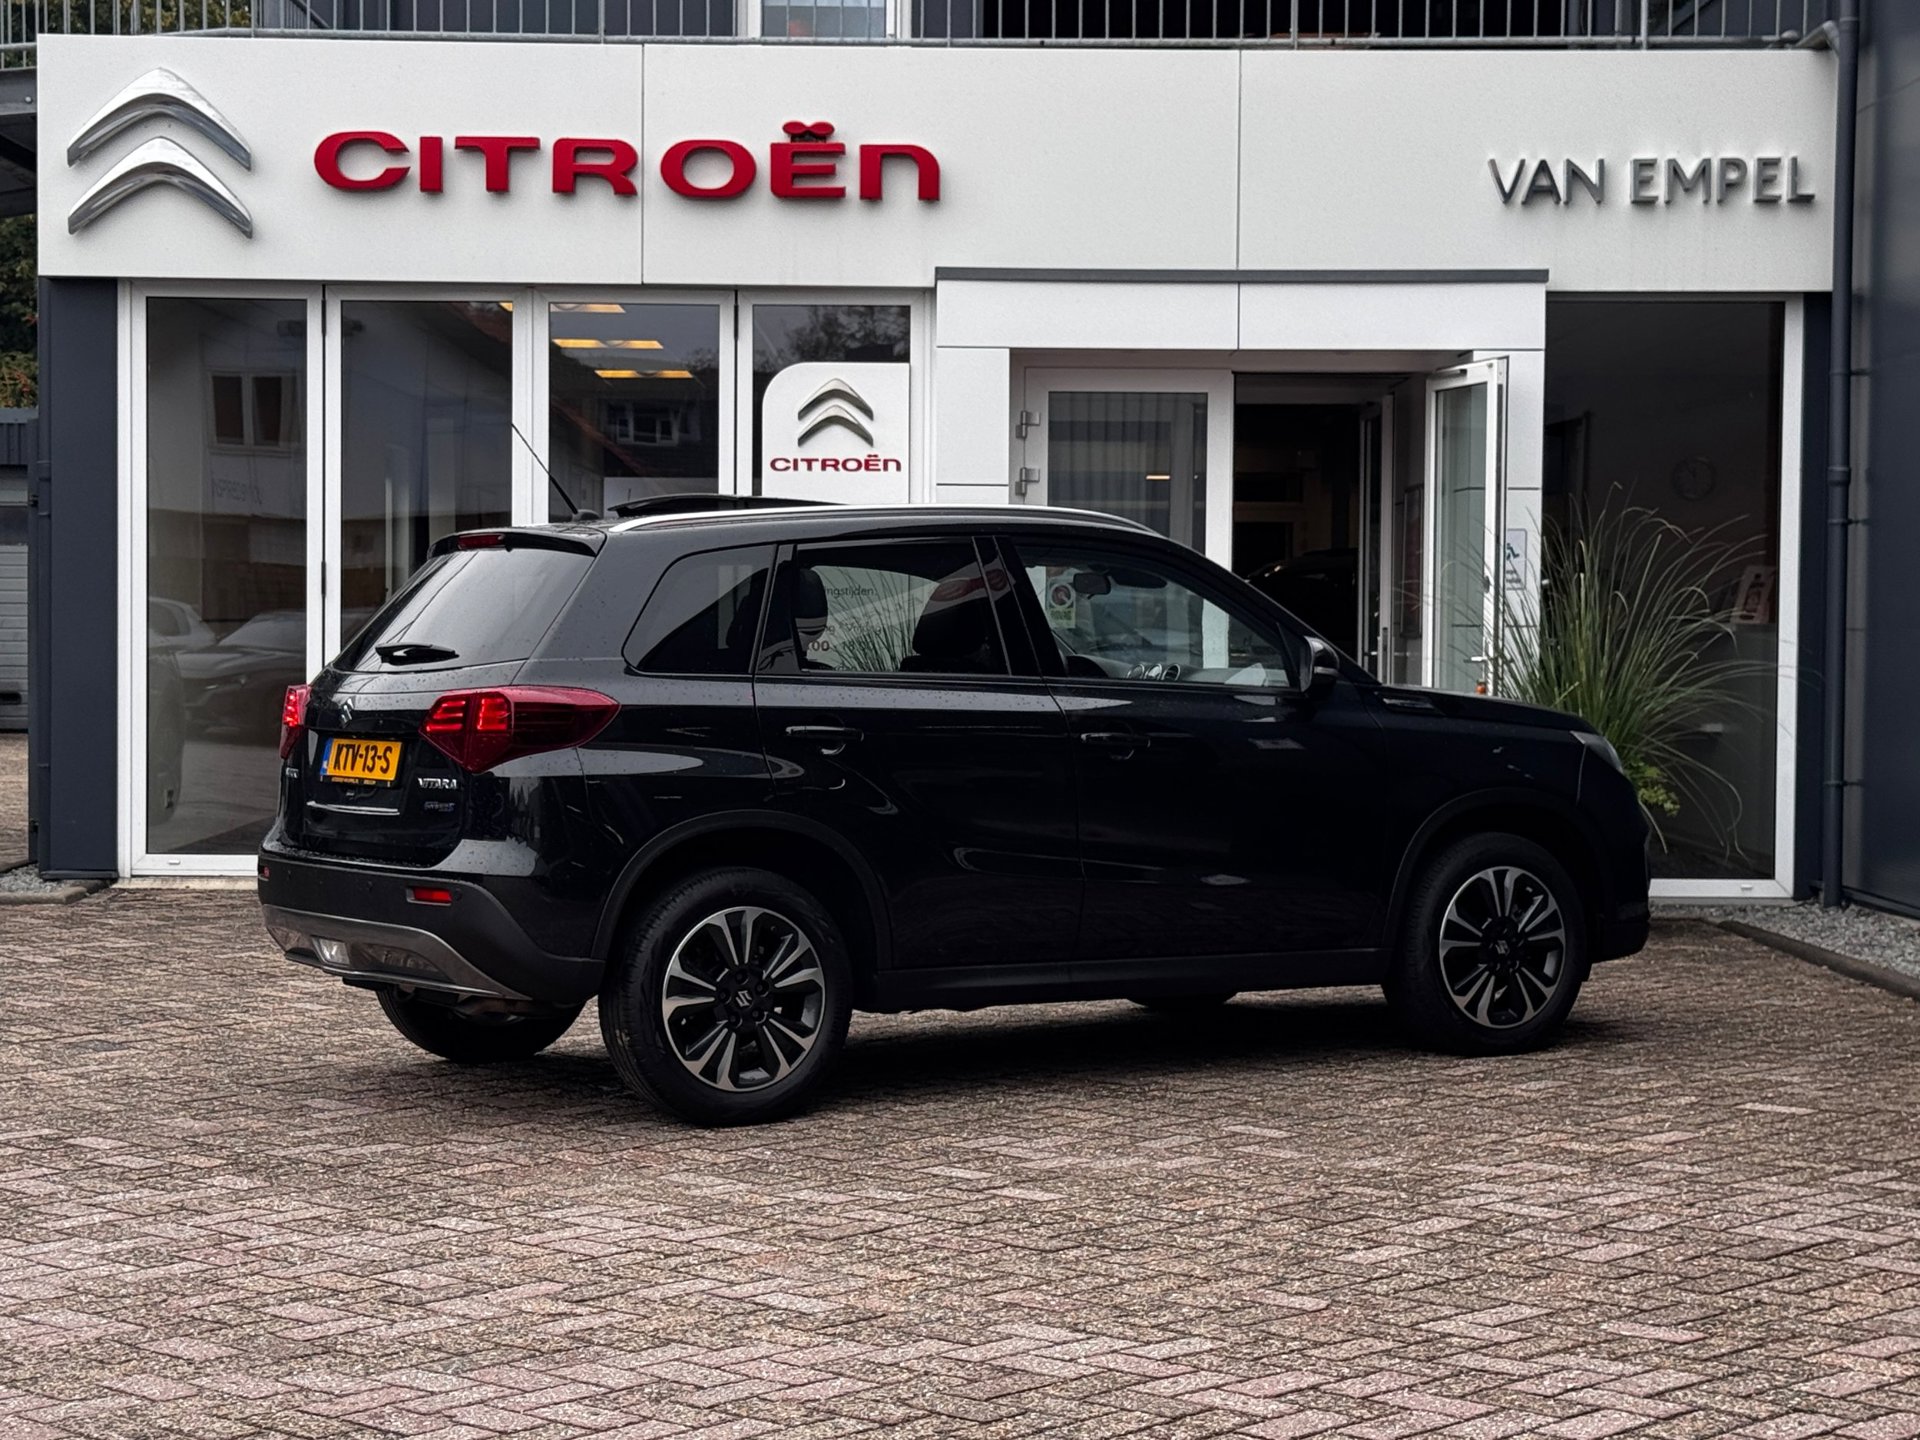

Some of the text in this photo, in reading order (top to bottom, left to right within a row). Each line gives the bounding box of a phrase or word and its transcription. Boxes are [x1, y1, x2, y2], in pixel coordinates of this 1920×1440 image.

[1488, 156, 1815, 205] VAN EMPEL
[824, 584, 875, 599] ngstijden
[332, 743, 393, 774] KTV-13-S
